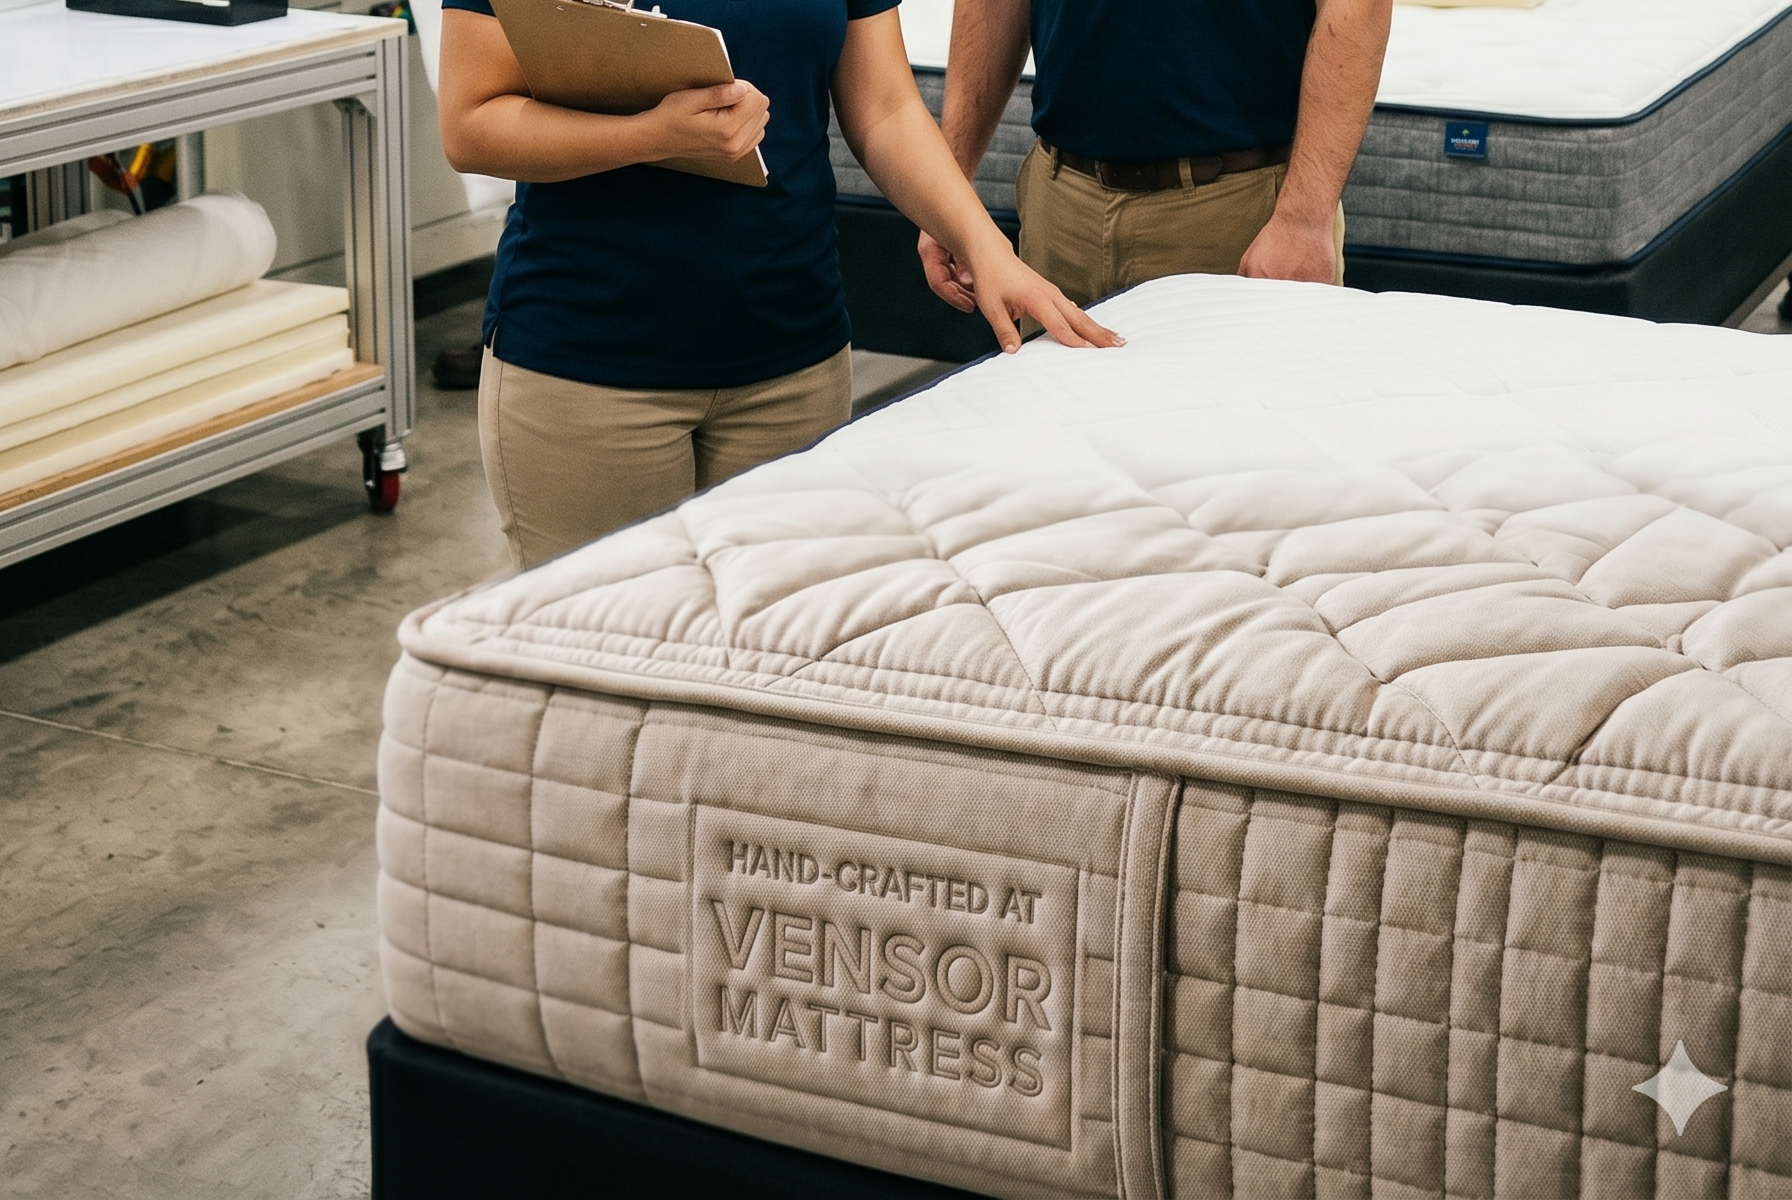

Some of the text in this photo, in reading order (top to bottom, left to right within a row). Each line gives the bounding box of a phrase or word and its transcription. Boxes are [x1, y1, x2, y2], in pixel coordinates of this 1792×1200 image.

[729, 840, 1042, 924] HAND-CRAFTED AT
[711, 900, 1052, 1031] VENSOR
[719, 985, 1045, 1098] MATTRESS
